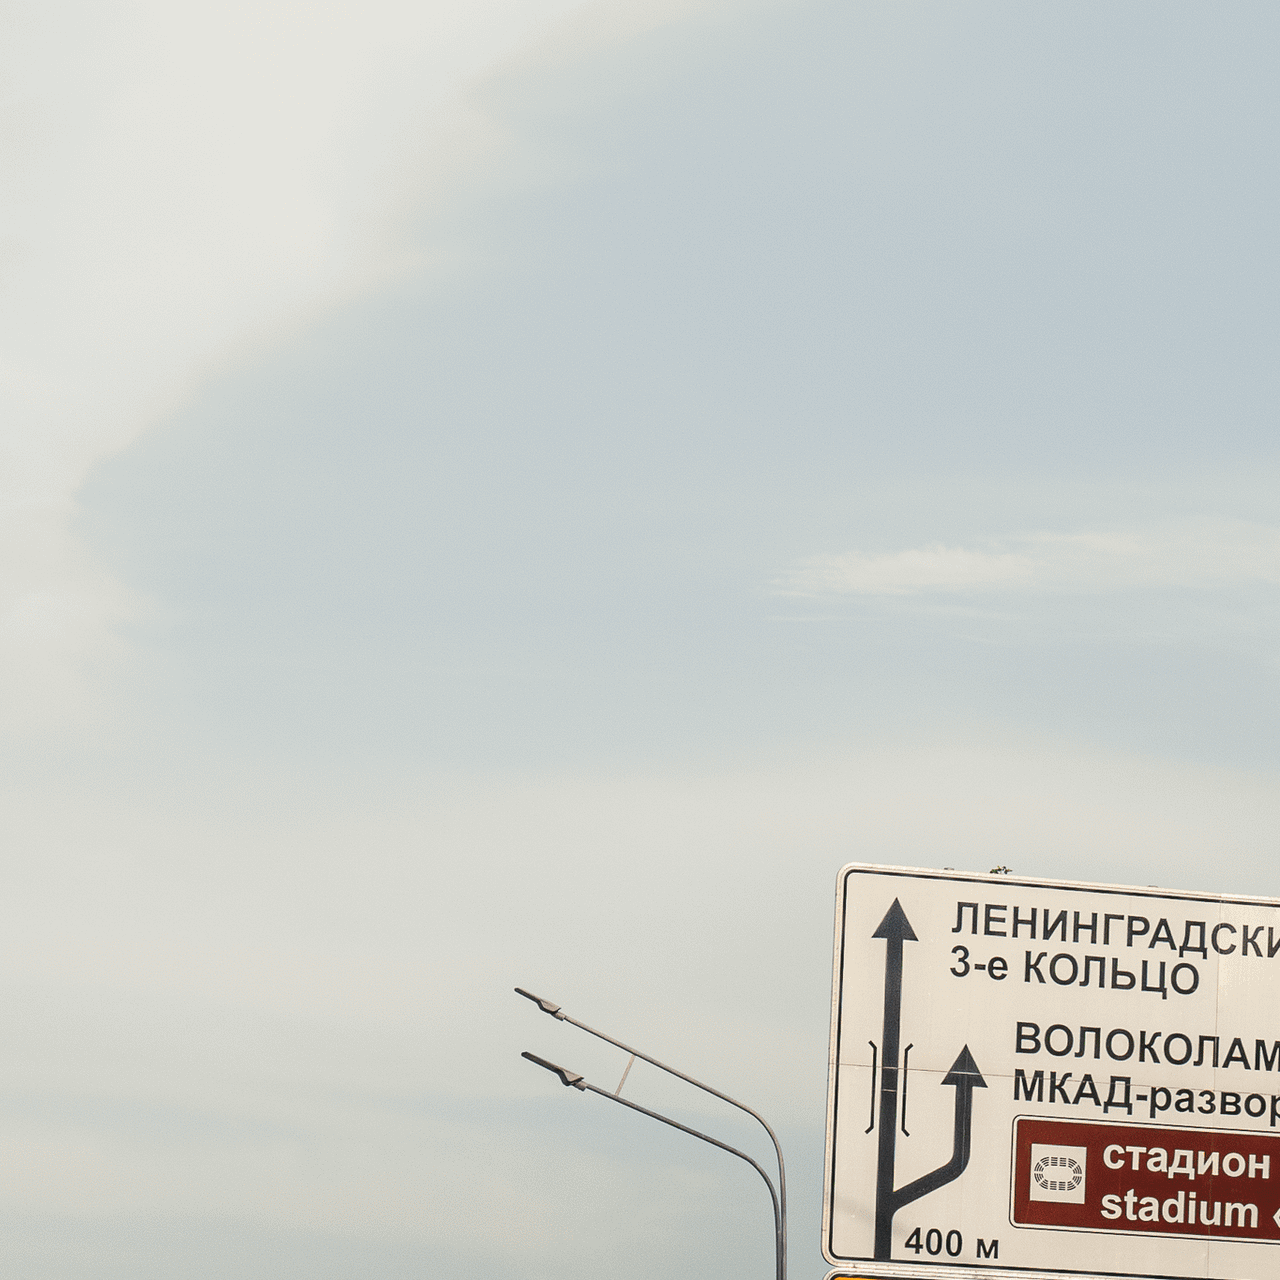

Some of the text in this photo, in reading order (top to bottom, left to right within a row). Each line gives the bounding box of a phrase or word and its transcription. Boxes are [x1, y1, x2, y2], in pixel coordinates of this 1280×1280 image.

[949, 946, 1200, 1000] 3-е КОЛЬЦО
[1101, 1142, 1270, 1181] стадион
[1100, 1188, 1259, 1228] stadium
[904, 1227, 999, 1259] 400 м
